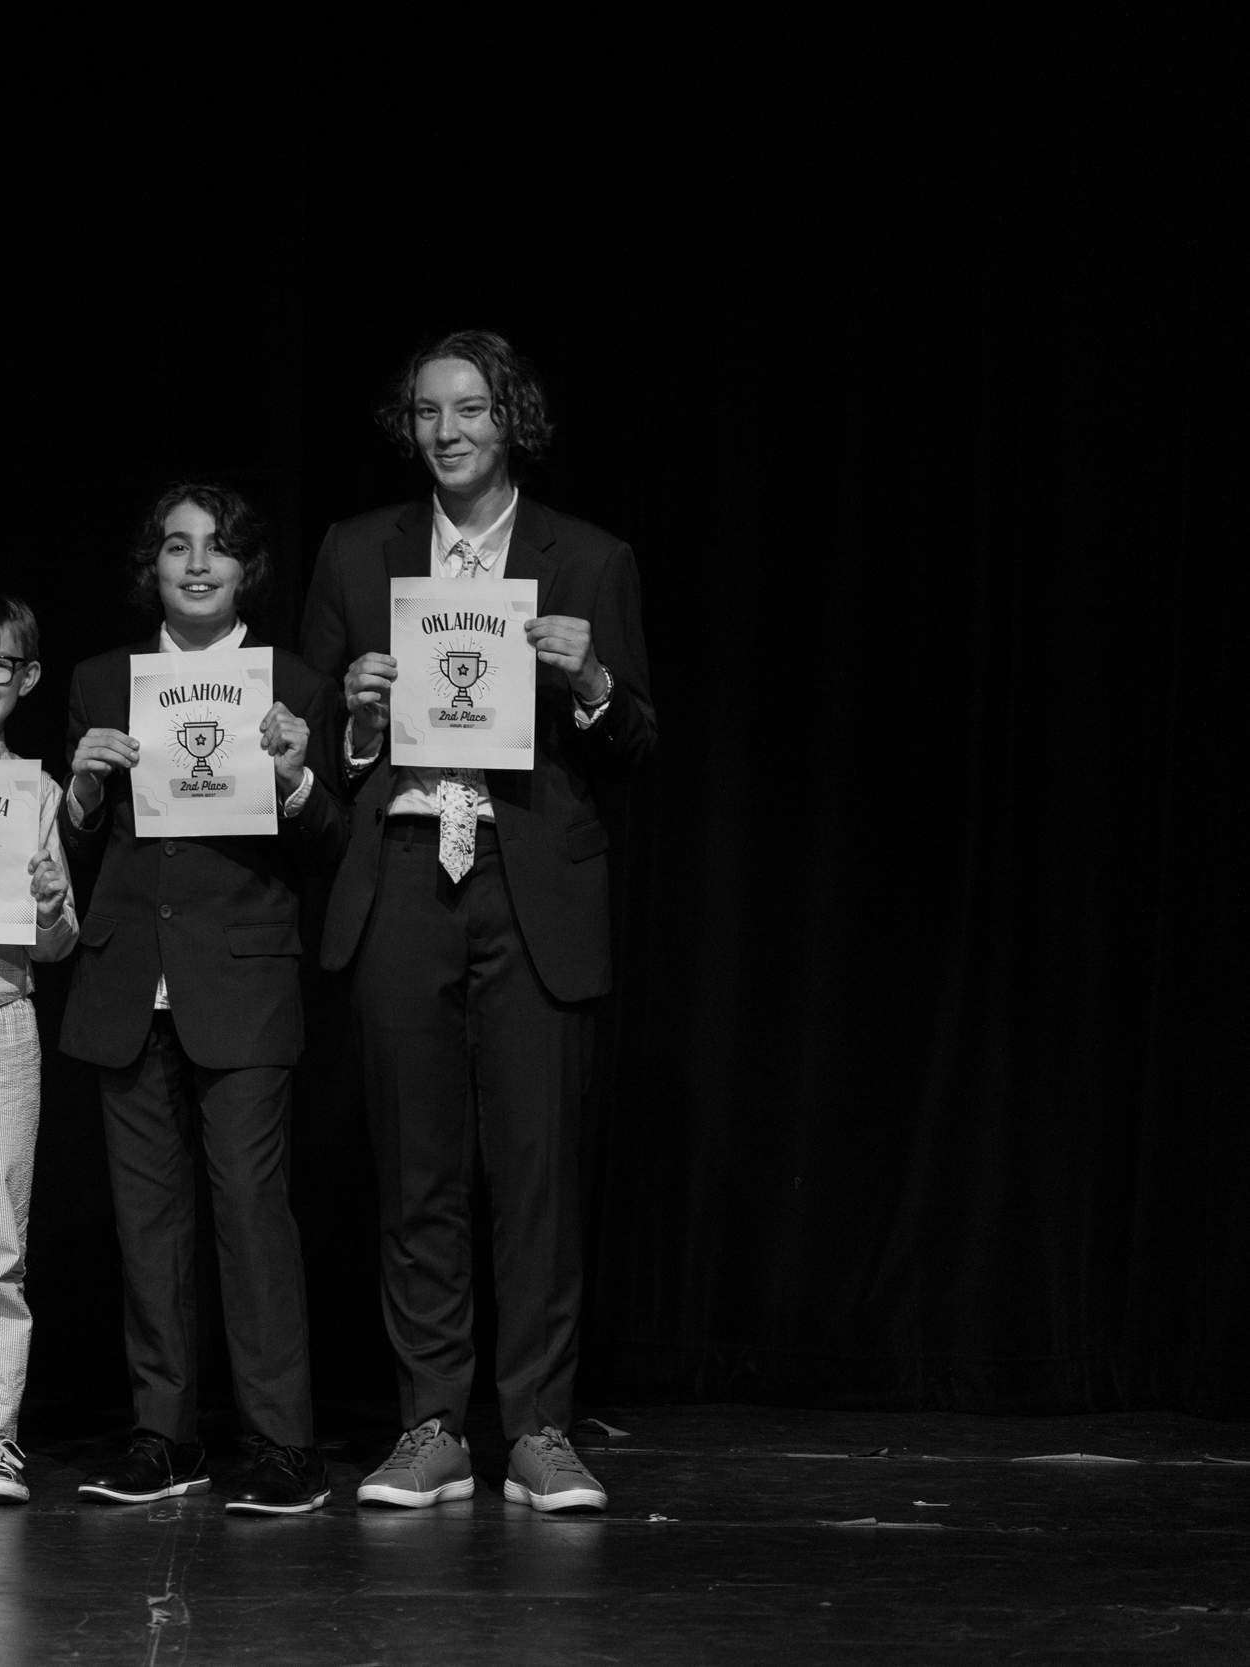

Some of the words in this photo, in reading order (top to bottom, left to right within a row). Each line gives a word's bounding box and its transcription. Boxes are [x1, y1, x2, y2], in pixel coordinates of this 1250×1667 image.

[421, 612, 506, 638] OKLAHOMA
[159, 683, 242, 708] OKLAHOMA
[438, 710, 458, 721] 2nd
[460, 711, 487, 722] Place
[180, 781, 199, 791] 2nd
[201, 780, 228, 791] Place
